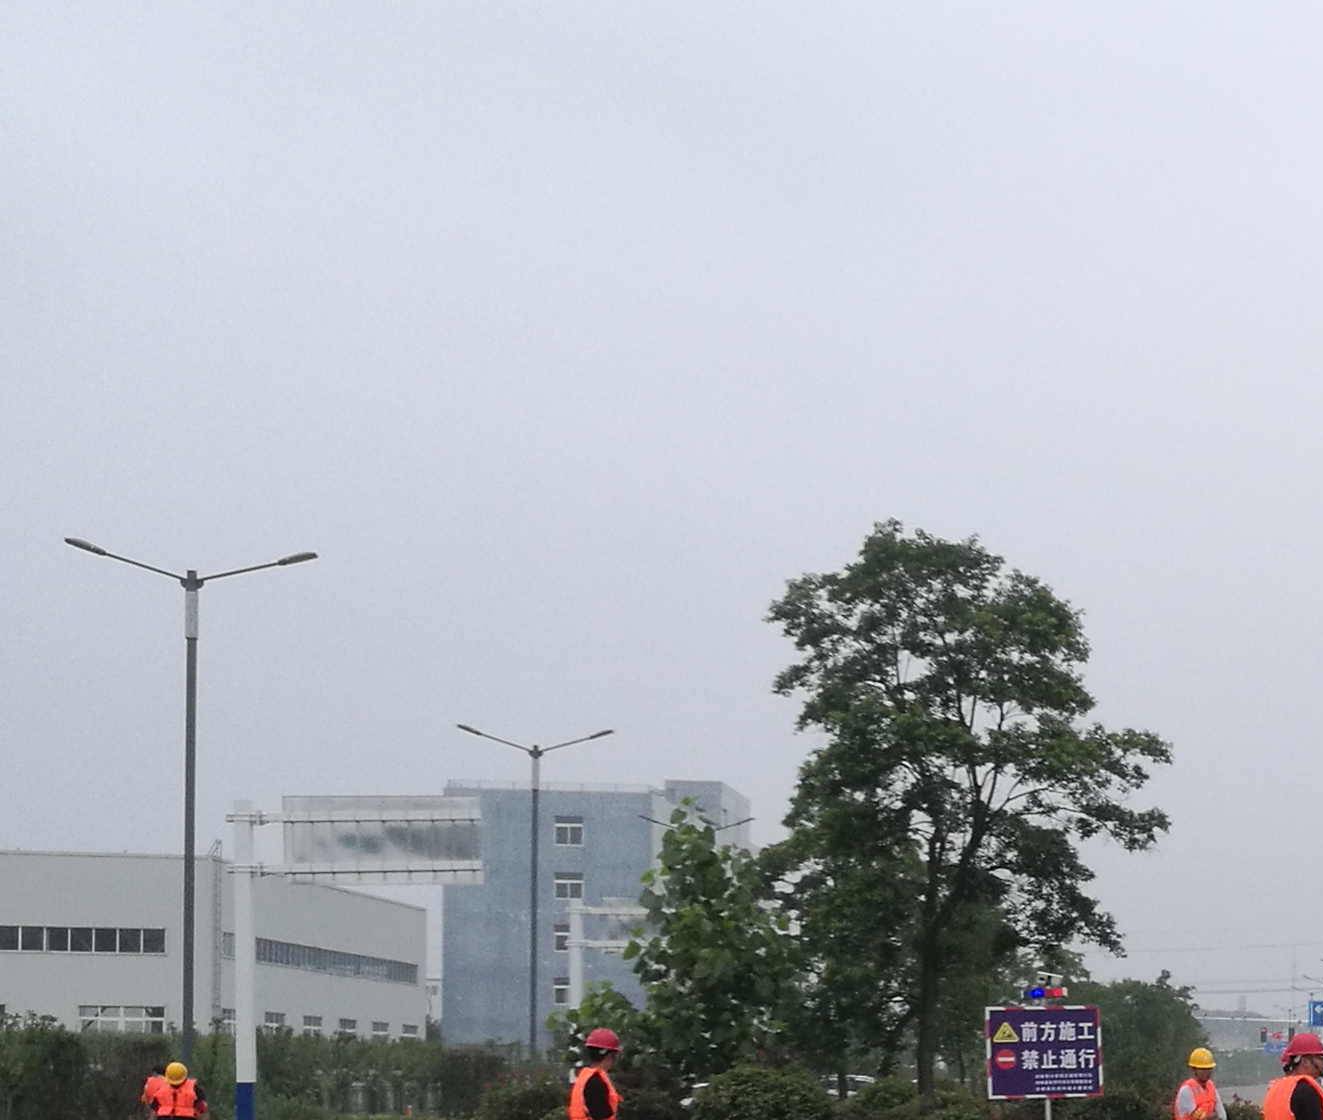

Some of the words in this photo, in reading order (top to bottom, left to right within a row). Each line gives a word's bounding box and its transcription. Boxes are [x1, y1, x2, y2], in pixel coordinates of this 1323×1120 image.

[1020, 1021, 1095, 1042] 前方施工
[1020, 1048, 1096, 1070] 禁止通行
